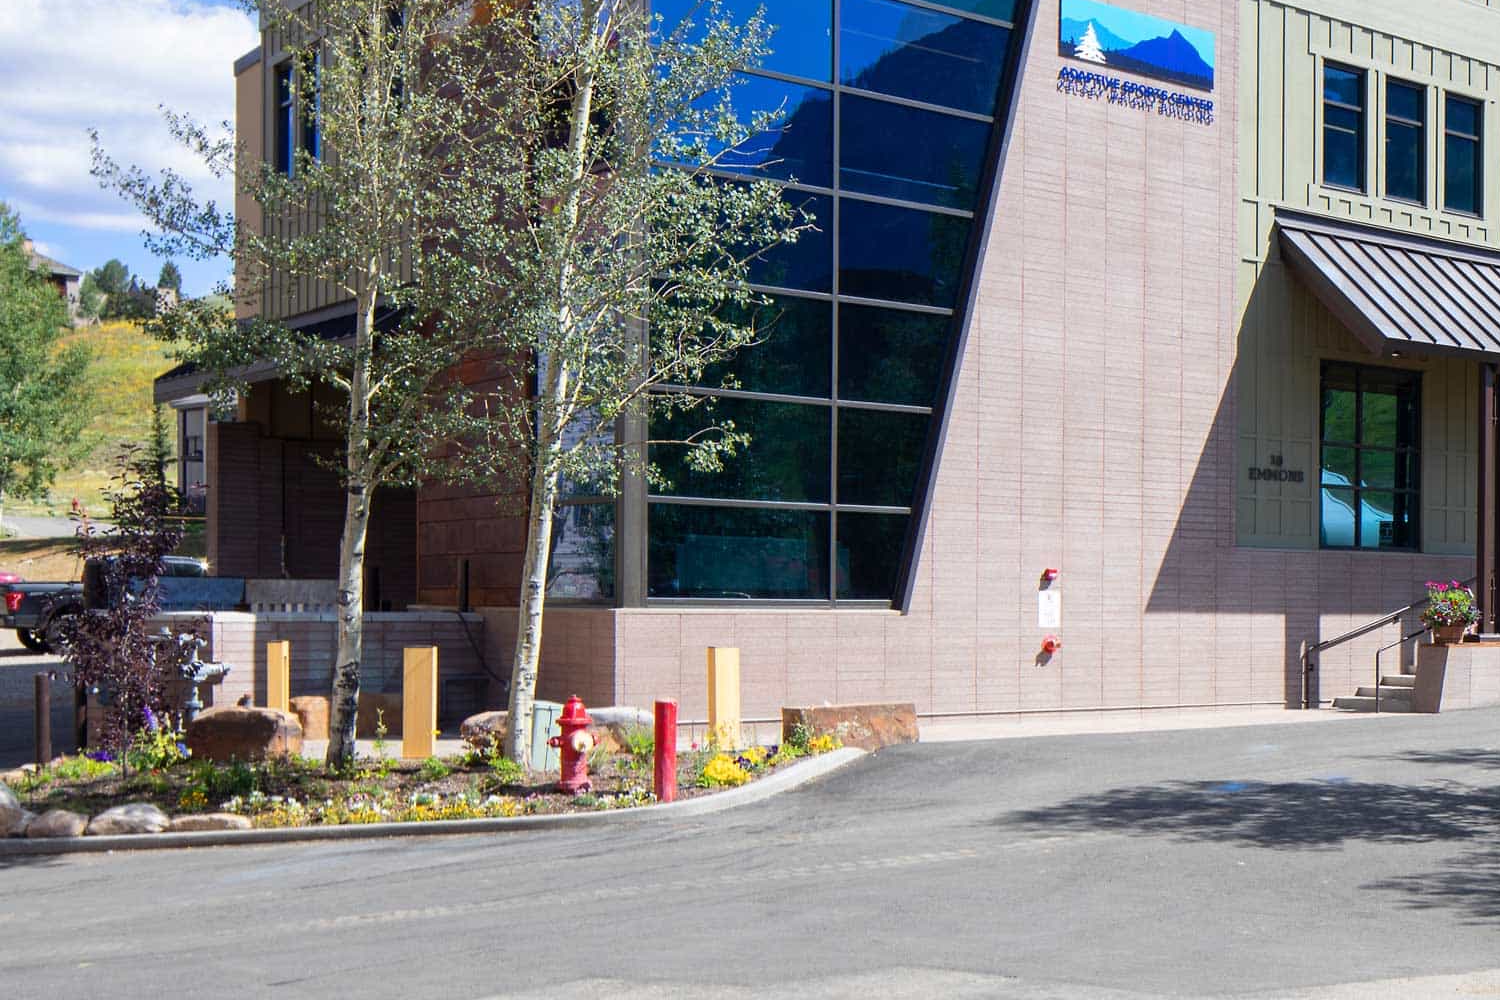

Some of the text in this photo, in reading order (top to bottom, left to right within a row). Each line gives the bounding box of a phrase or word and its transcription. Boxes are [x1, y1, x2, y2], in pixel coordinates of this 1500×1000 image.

[1057, 80, 1214, 126] KELSEY WRIGHT BUILDING
[1060, 66, 1214, 111] ADAPTIVE SPORTS CENTER
